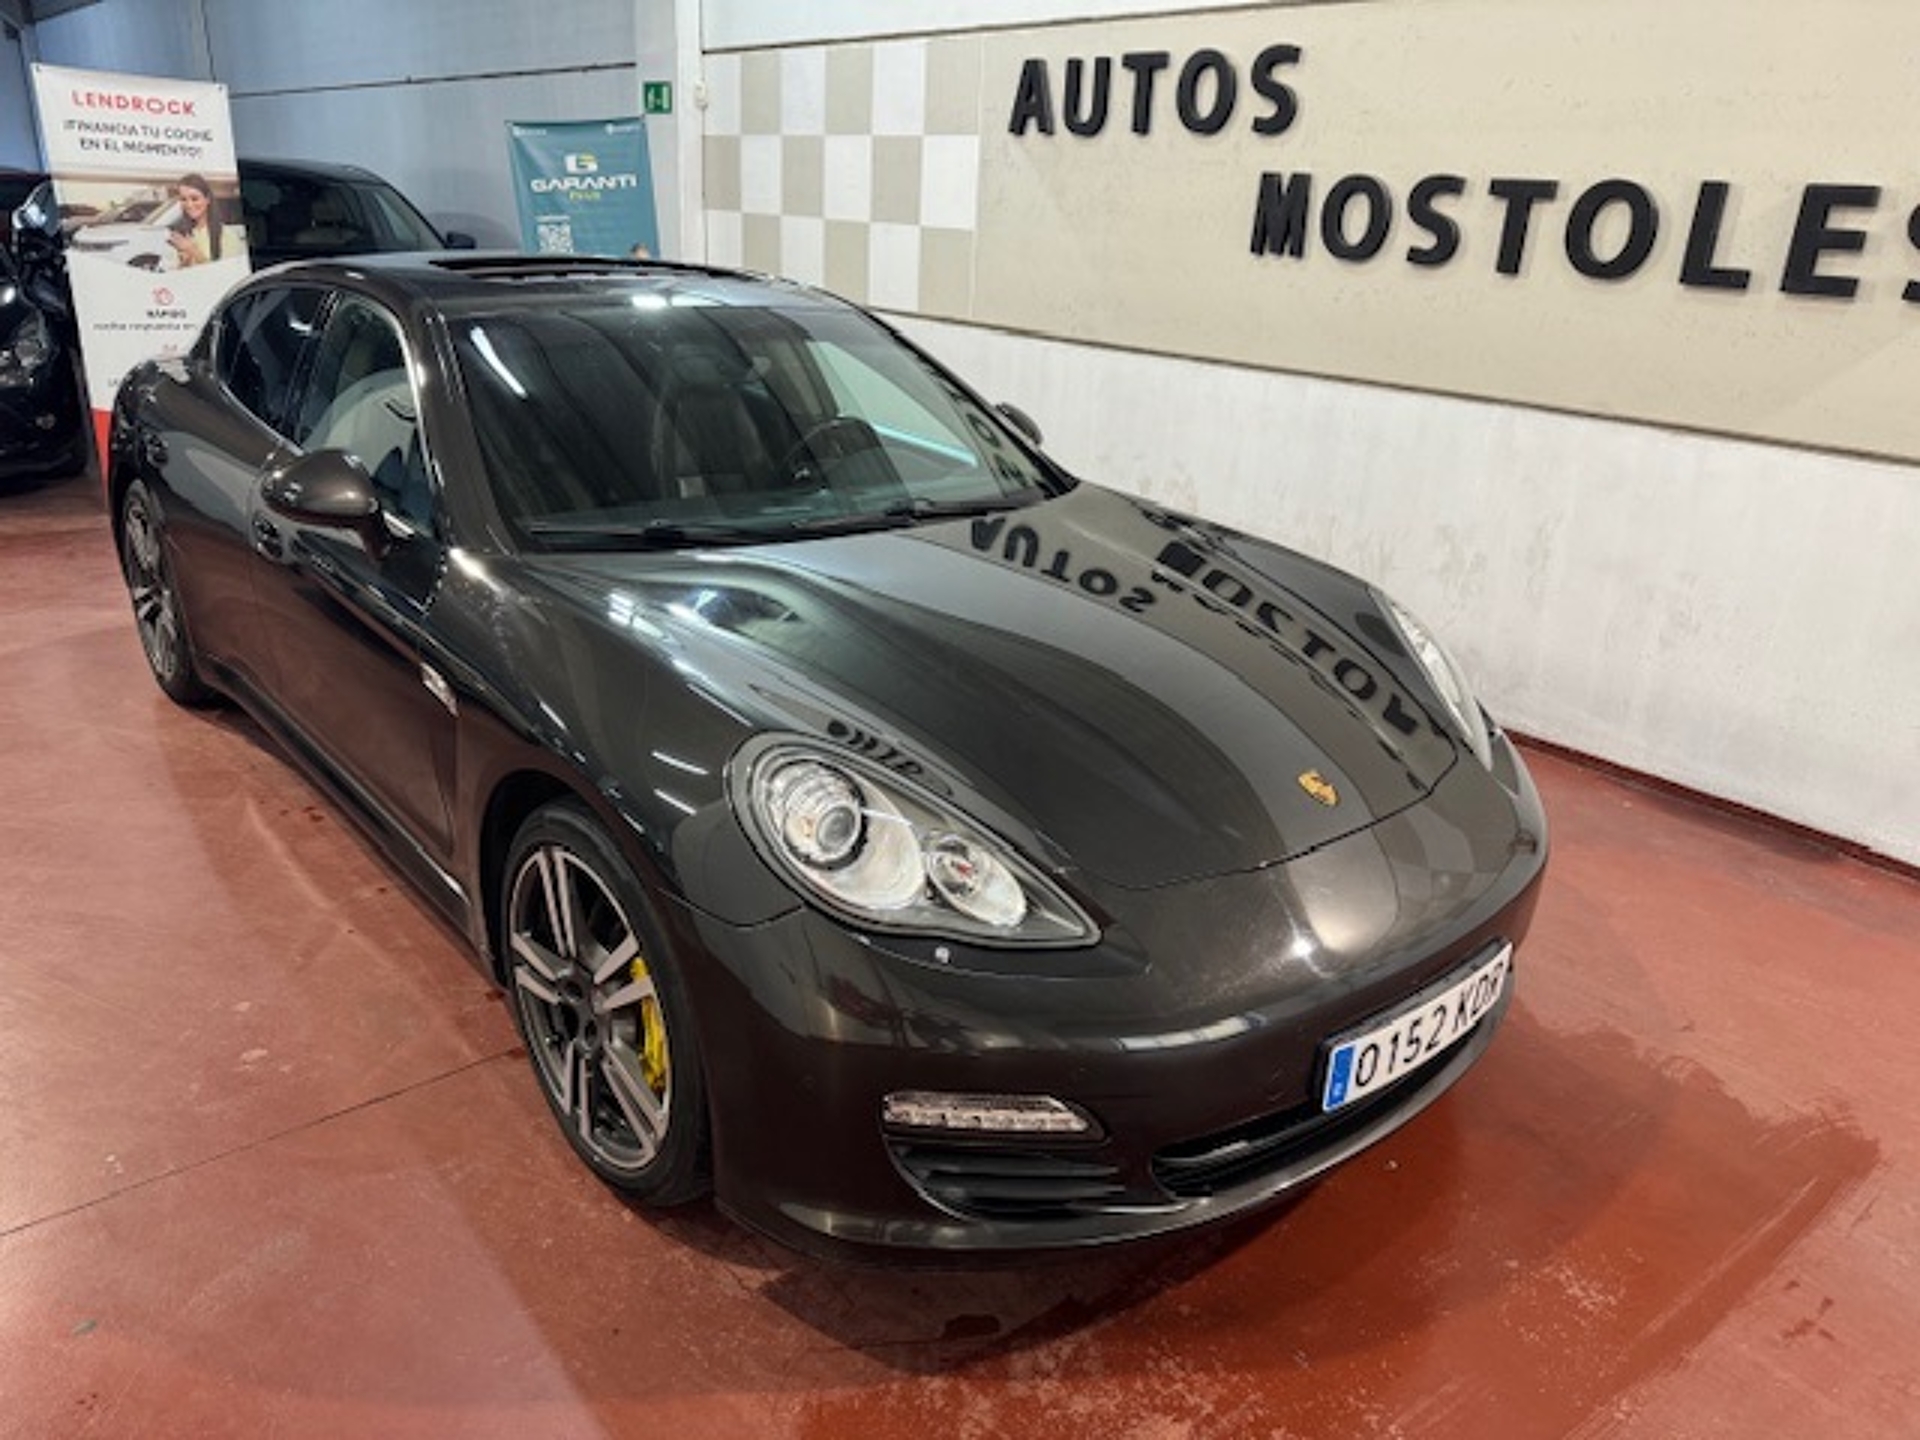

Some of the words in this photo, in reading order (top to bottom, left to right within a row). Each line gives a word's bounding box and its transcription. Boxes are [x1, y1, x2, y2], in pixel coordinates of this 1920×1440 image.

[71, 90, 195, 116] LENDROCK
[1009, 44, 1301, 137] AUTOS
[530, 174, 636, 193] GARANTI
[1356, 1004, 1447, 1087] 0152
